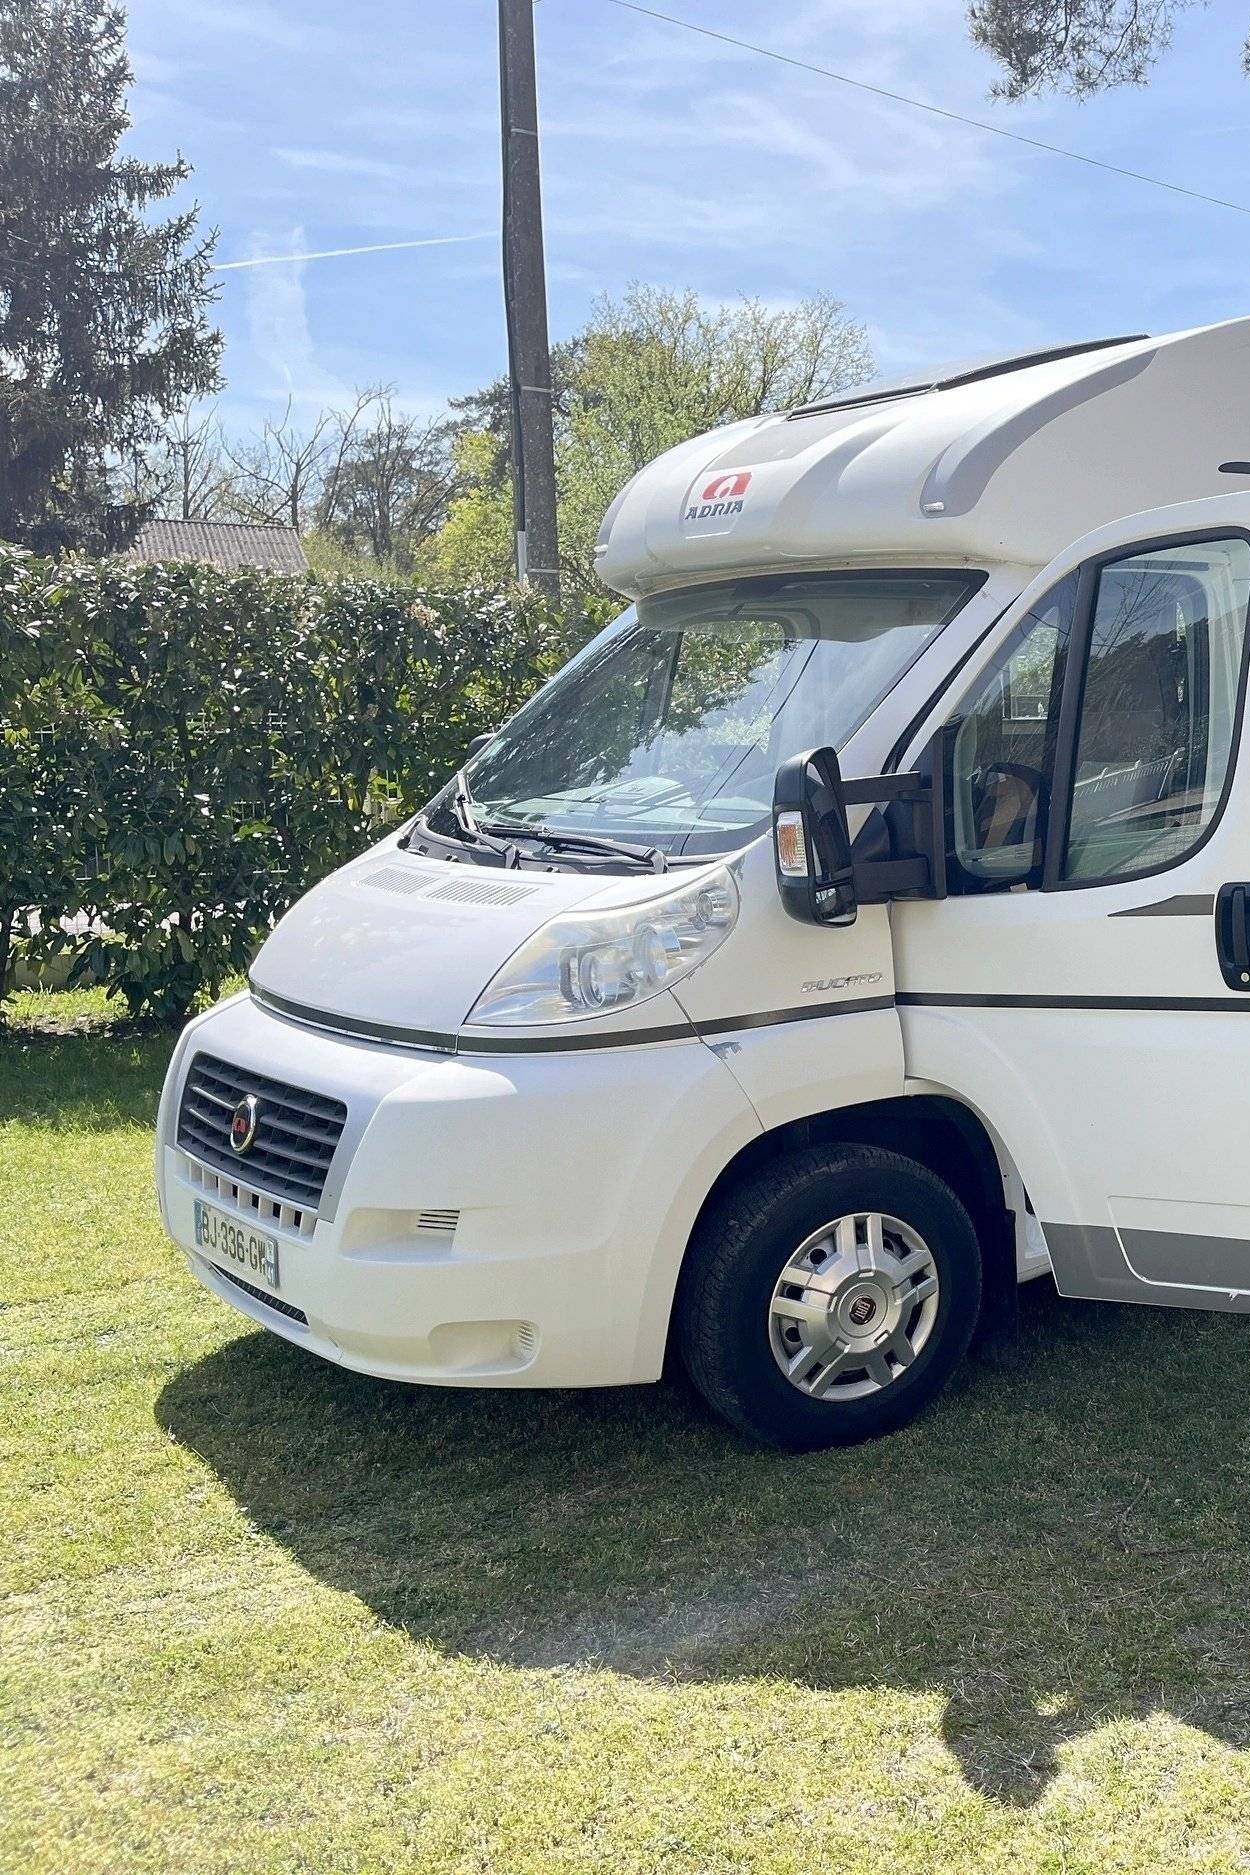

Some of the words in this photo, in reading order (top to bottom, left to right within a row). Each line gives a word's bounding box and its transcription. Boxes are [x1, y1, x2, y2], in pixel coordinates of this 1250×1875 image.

[684, 499, 745, 520] ADRIA
[801, 972, 883, 993] DUCATO
[854, 1299, 871, 1319] FIAT
